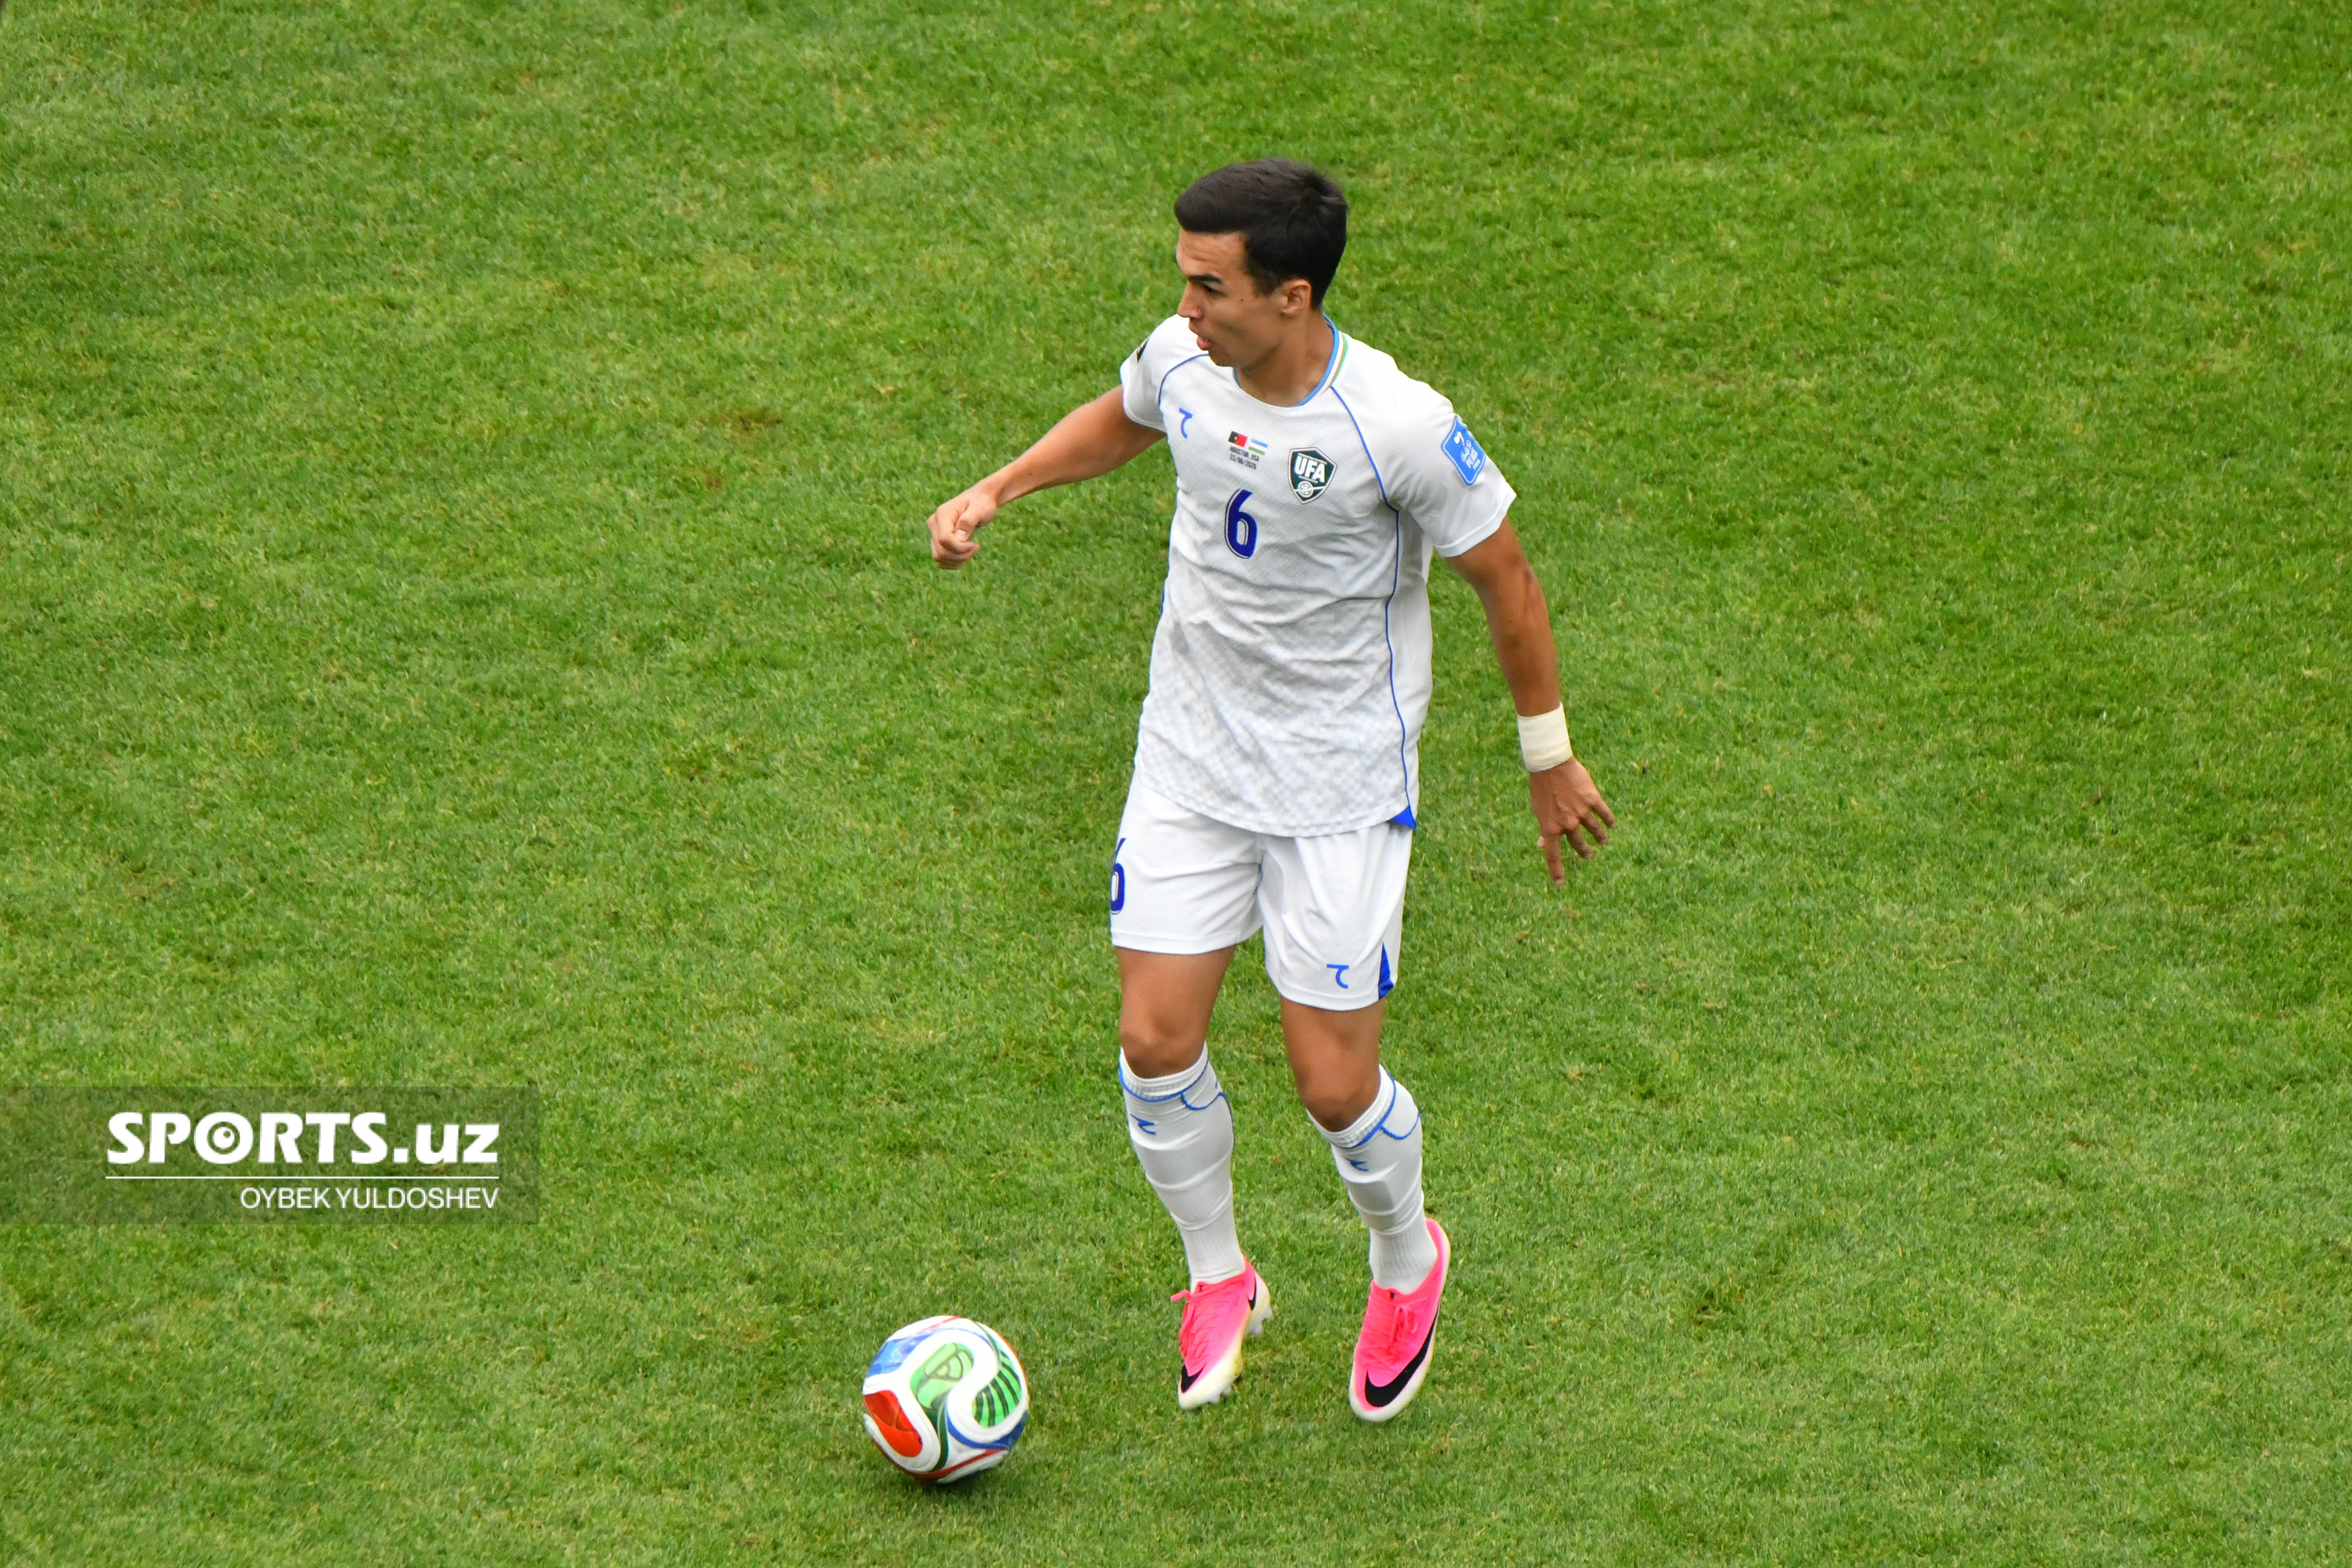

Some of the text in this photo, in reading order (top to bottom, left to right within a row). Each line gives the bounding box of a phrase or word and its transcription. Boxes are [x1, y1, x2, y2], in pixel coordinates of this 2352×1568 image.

[1251, 453, 1260, 462] USA
[1294, 455, 1325, 483] UFA
[1225, 488, 1258, 560] 6
